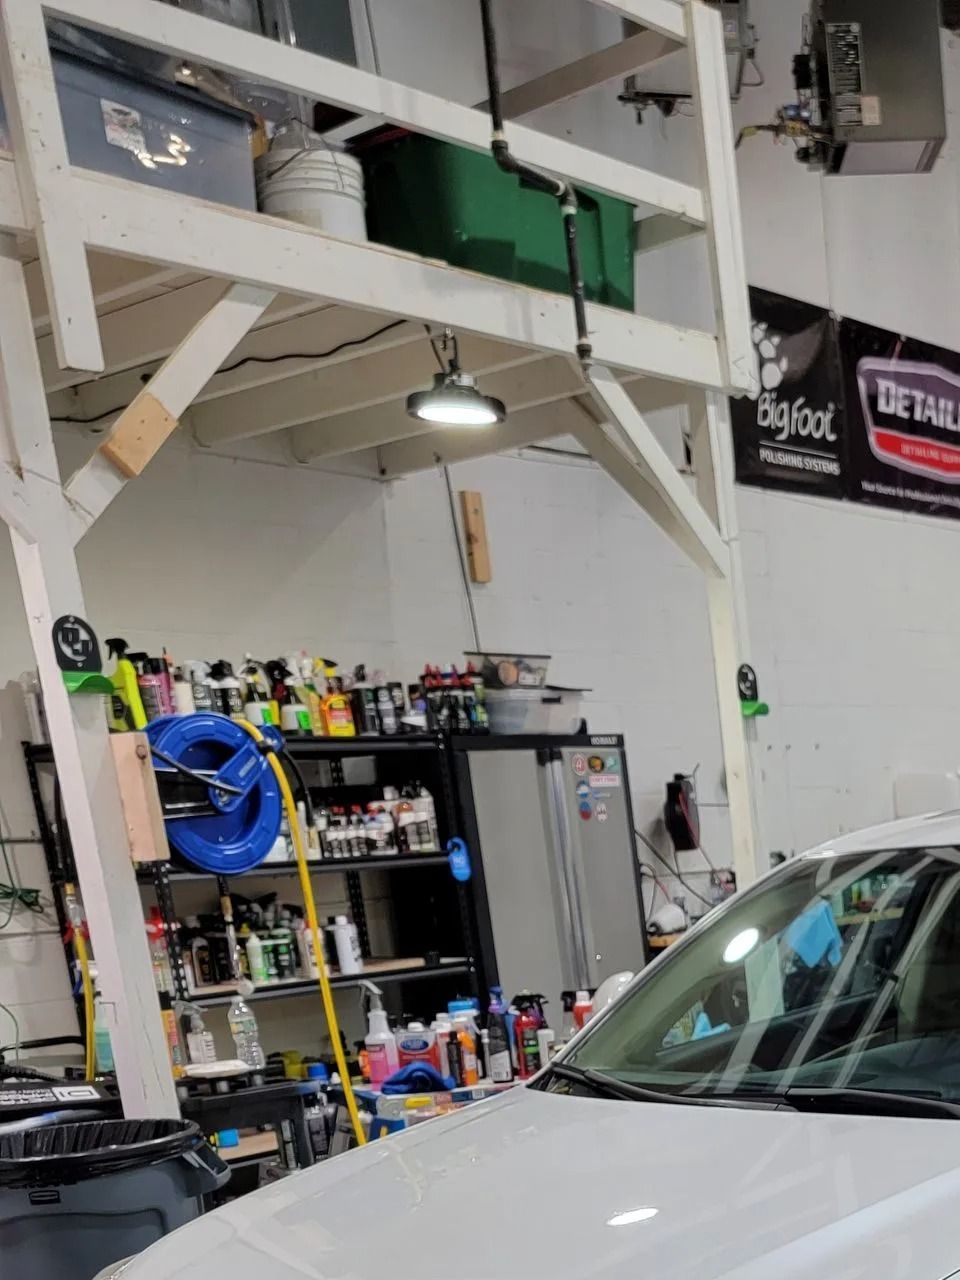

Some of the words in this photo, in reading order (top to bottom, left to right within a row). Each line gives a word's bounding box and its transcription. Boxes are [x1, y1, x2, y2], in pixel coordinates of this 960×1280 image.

[757, 391, 838, 442] Bigfoot
[759, 447, 803, 469] POLISHING
[804, 456, 840, 476] SYSTEMS
